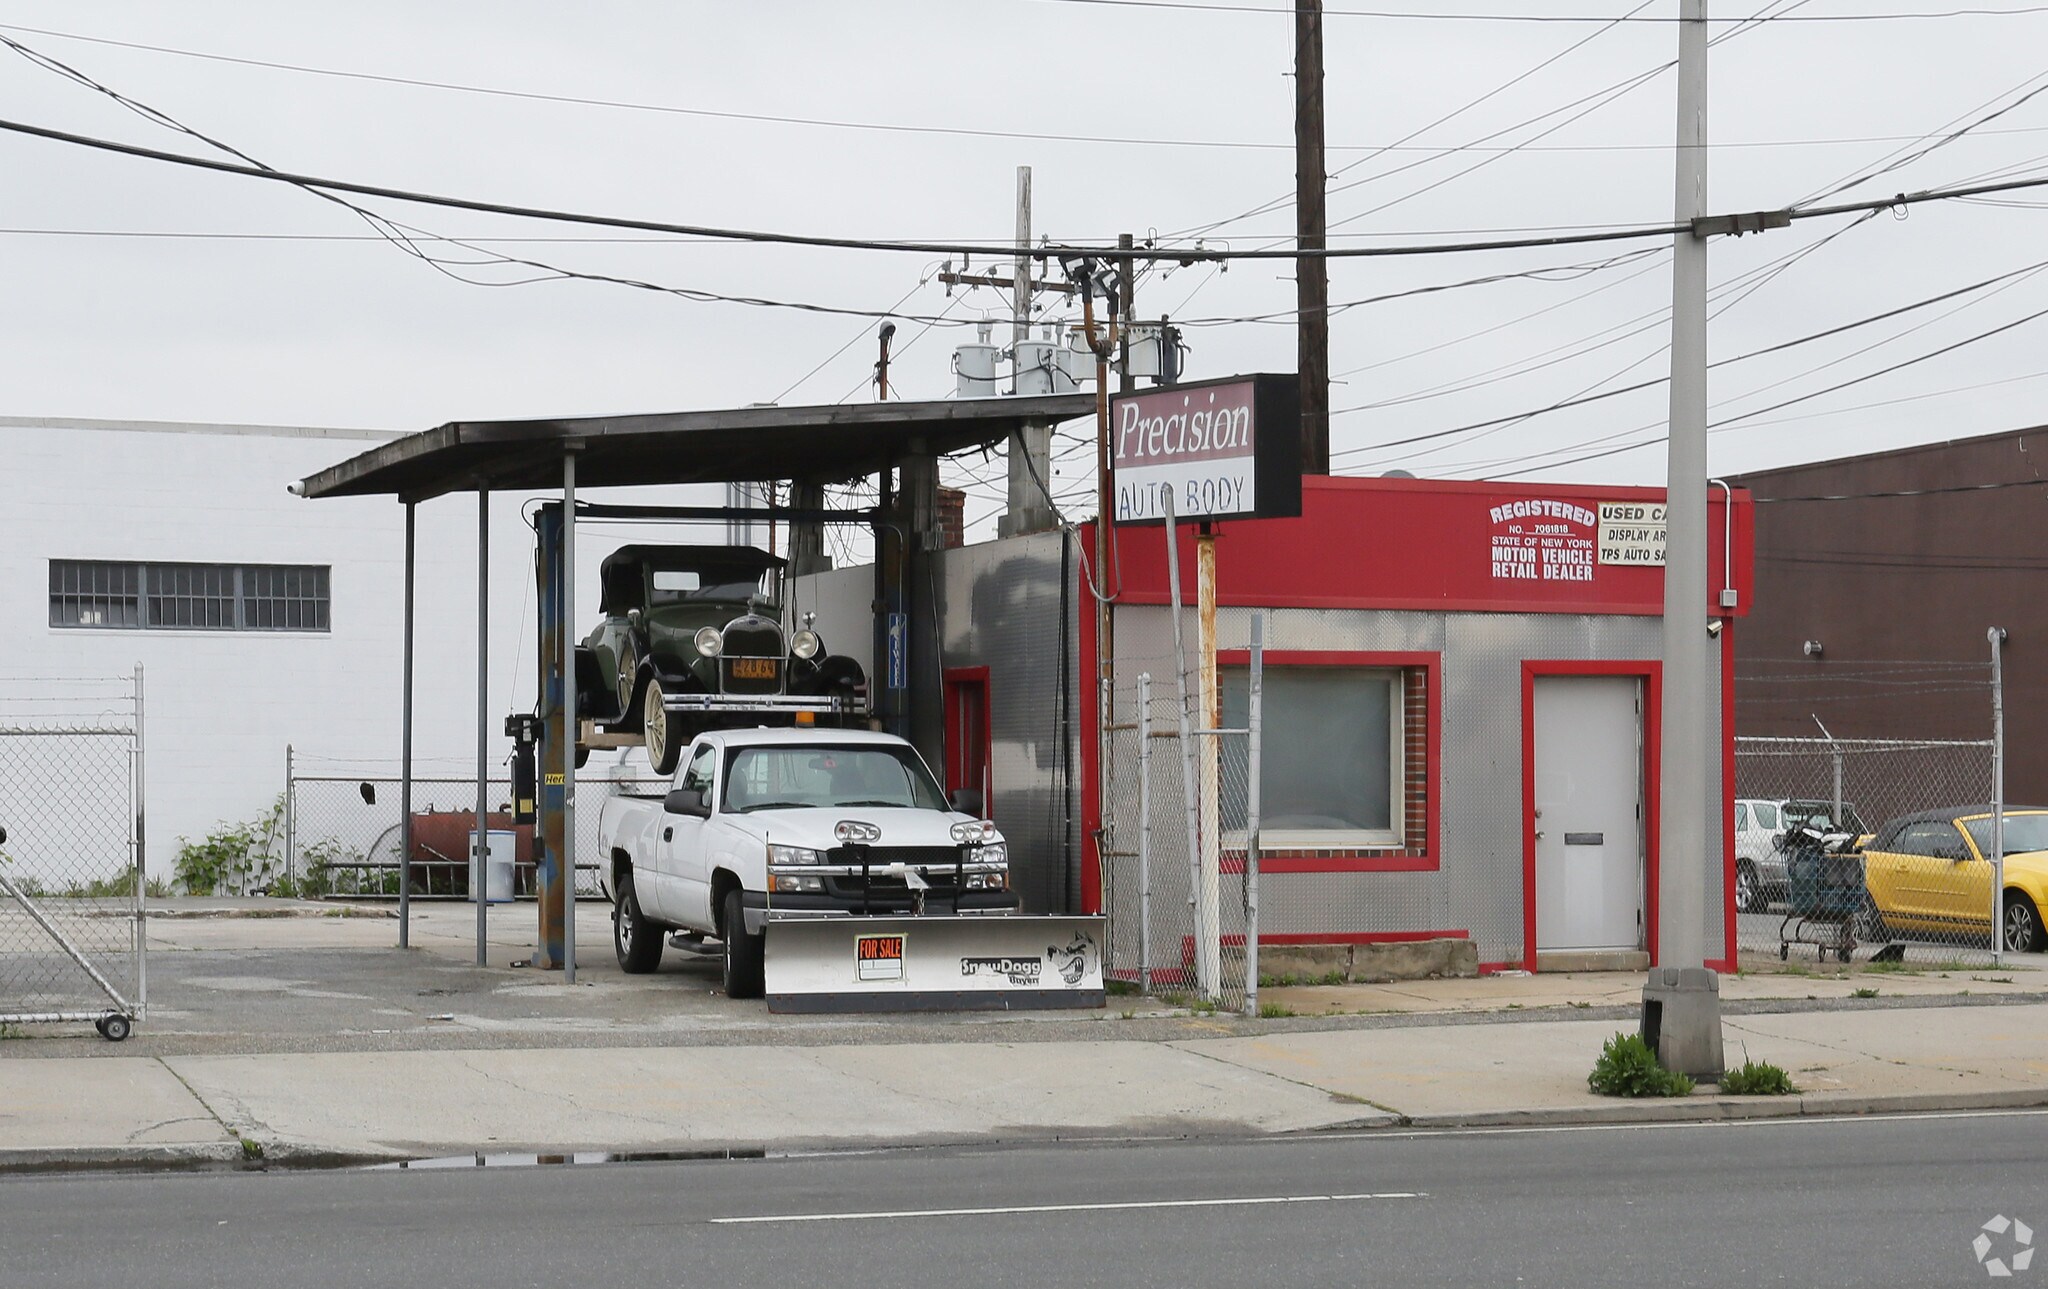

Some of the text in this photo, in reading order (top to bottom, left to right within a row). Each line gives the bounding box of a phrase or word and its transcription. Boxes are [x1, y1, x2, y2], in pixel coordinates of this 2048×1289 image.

[1115, 391, 1250, 459] Precision
[1119, 476, 1244, 521] AUTO BODY
[1489, 499, 1596, 527] REGISTERED
[1602, 506, 1645, 520] USED
[1492, 536, 1593, 549] STATE OF NEW YORK
[1608, 529, 1649, 542] DISPLAY
[1491, 546, 1593, 565] MOTOR VEHICLE
[1601, 548, 1620, 560] TPS
[1623, 549, 1650, 561] AUTO
[1492, 562, 1593, 581] RETAIL DEALER
[859, 938, 901, 959] FOR SALE
